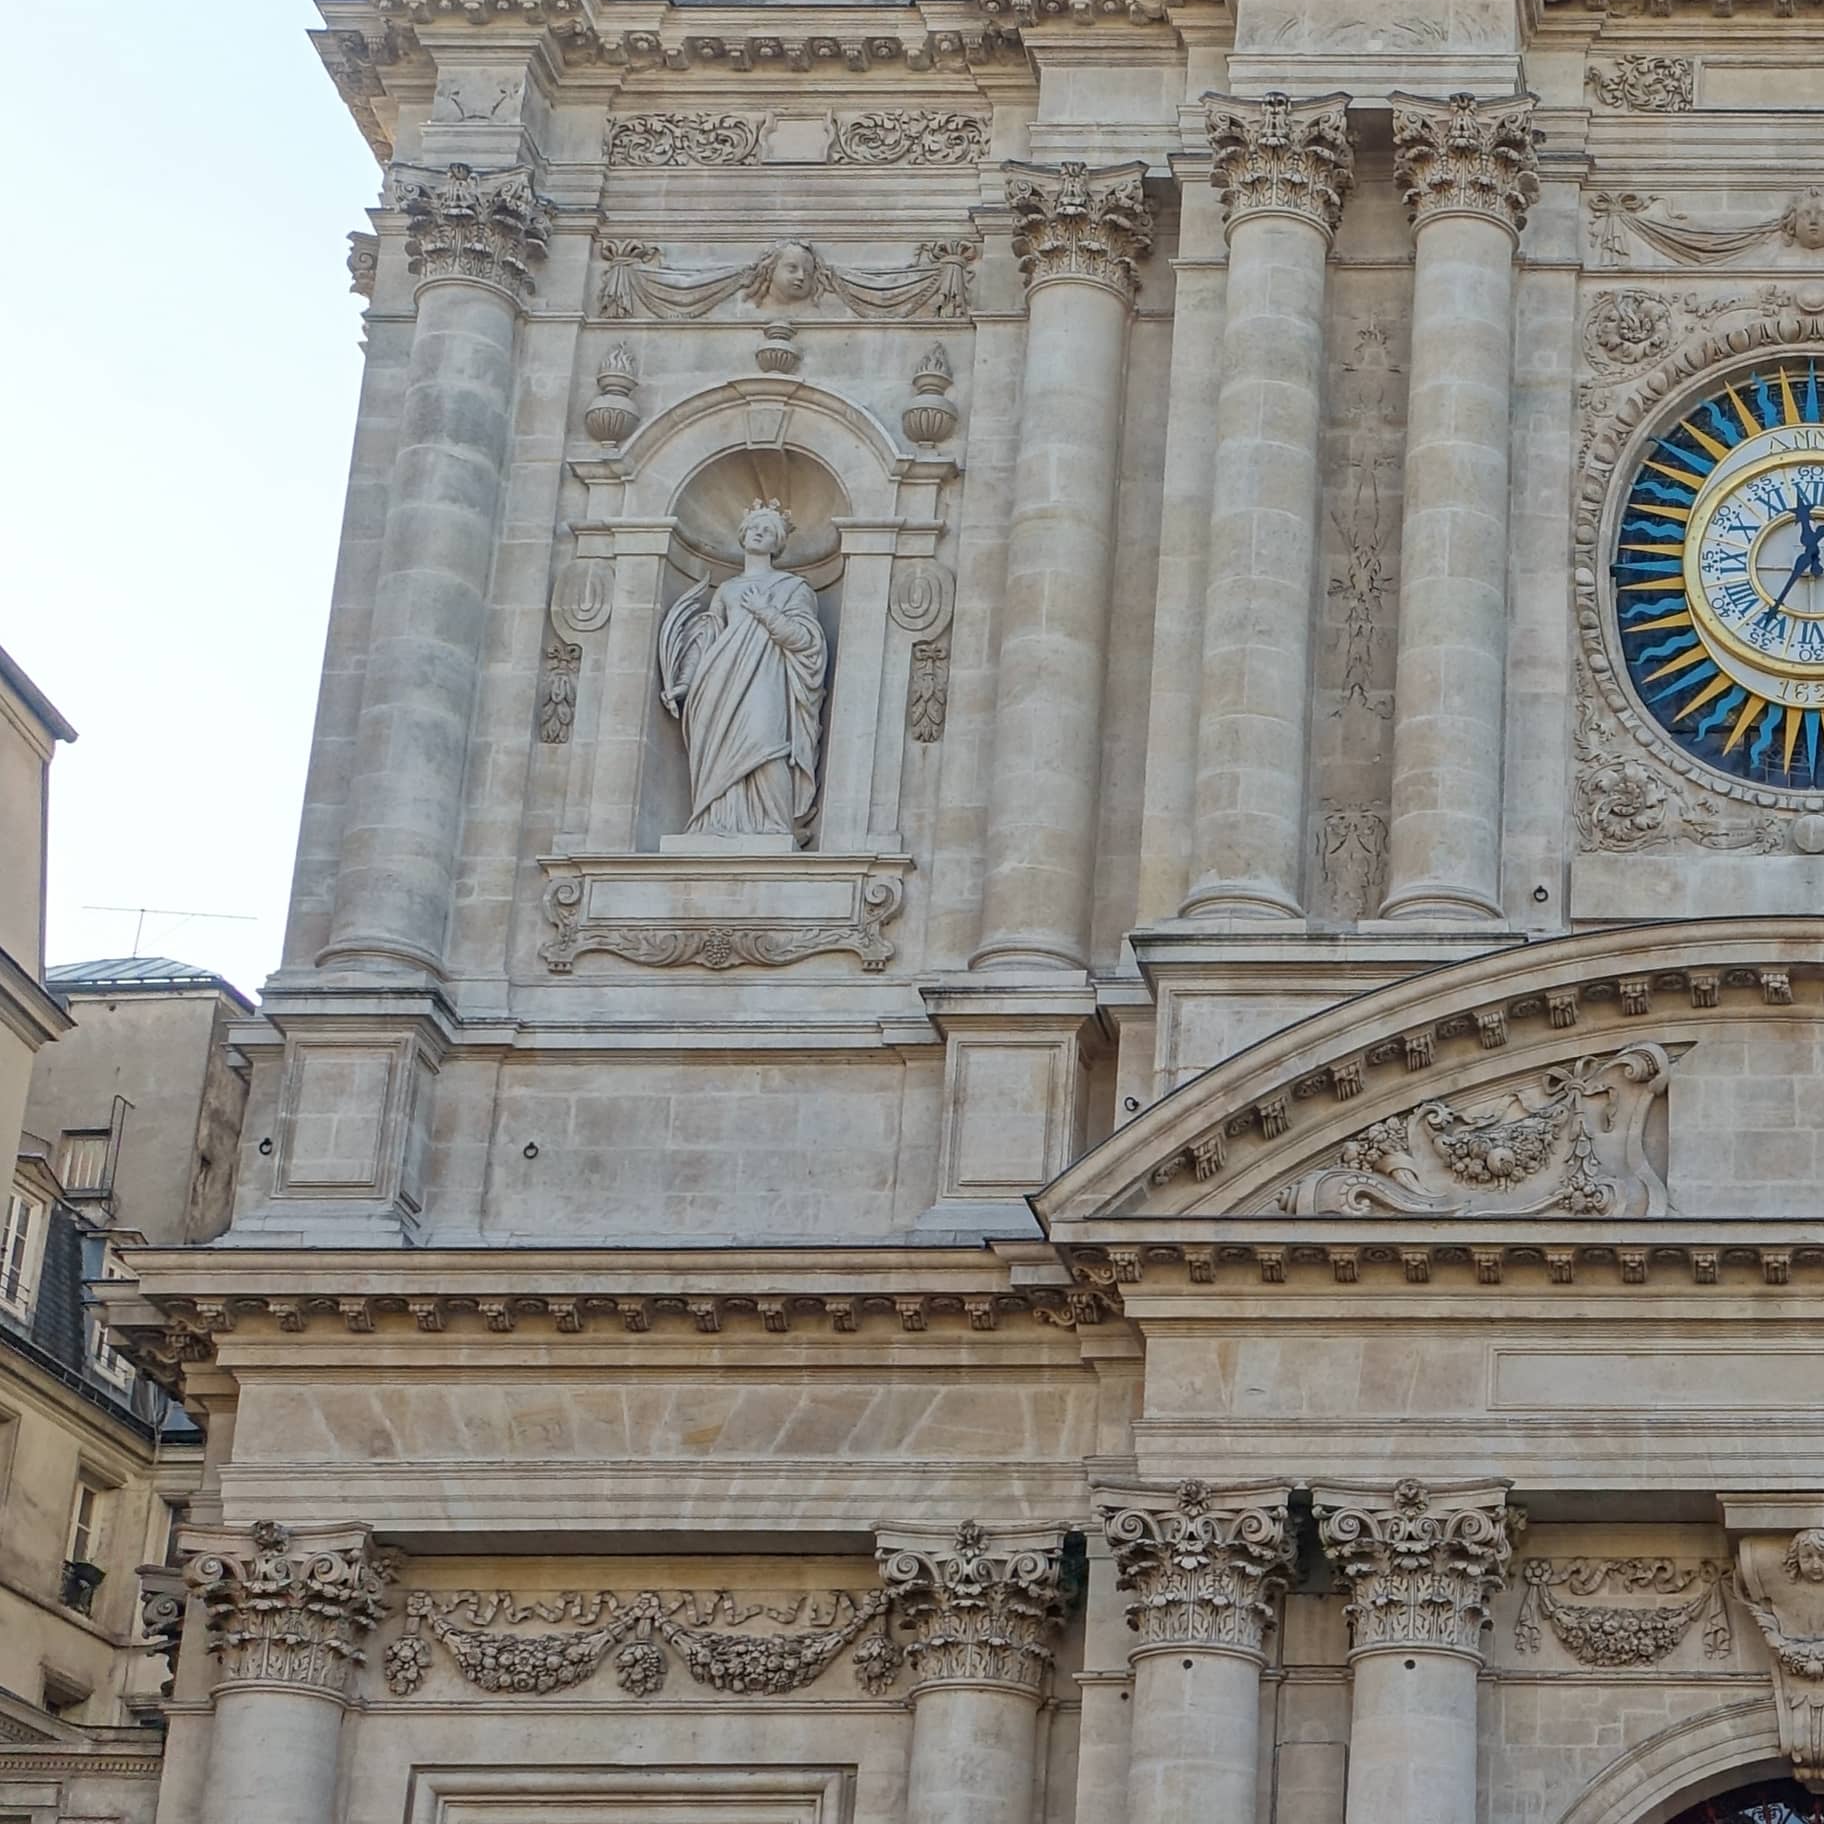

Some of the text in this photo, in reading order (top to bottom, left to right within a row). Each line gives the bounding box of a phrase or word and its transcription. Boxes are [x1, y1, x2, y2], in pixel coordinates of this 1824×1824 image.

[1712, 505, 1731, 526] 50
[1754, 487, 1787, 521] XI
[1727, 512, 1762, 544] X
[1702, 550, 1714, 573] 45
[1720, 549, 1748, 574] IX
[1711, 597, 1731, 618] 40
[1724, 581, 1760, 618] VIII
[1747, 632, 1773, 651] 35
[1799, 648, 1824, 661] 30
